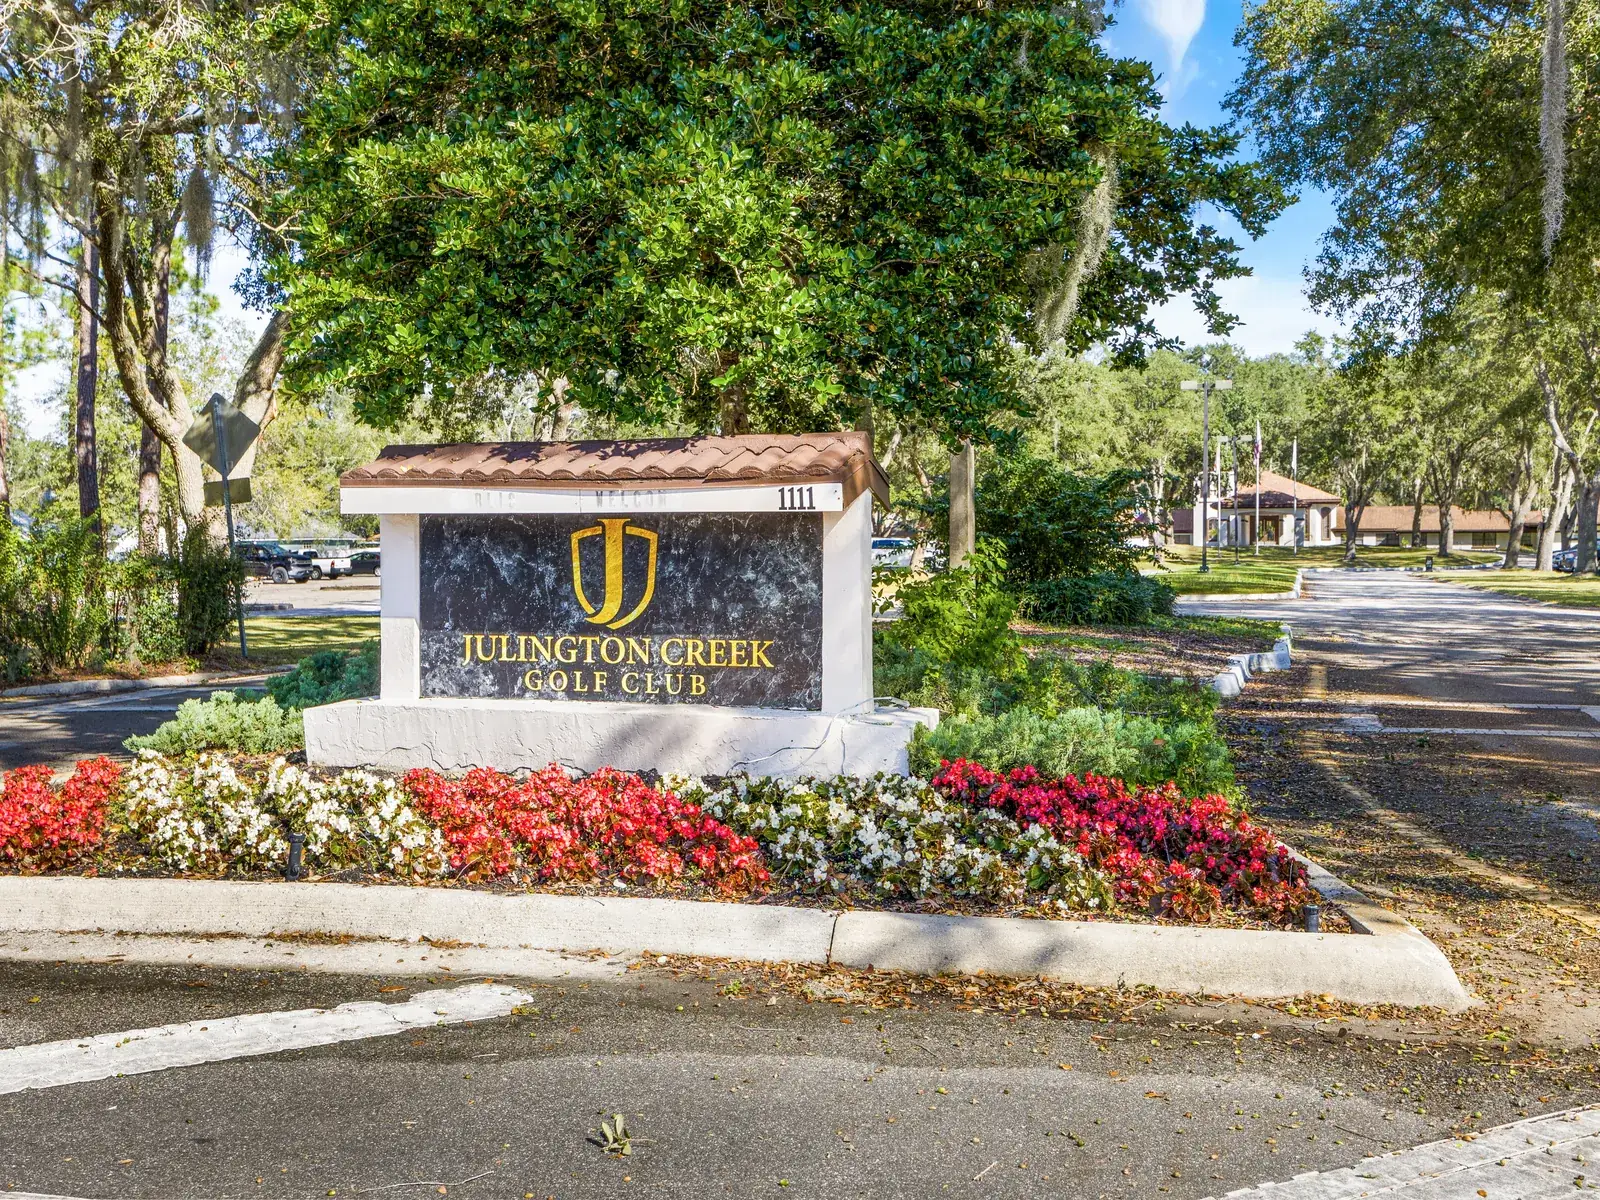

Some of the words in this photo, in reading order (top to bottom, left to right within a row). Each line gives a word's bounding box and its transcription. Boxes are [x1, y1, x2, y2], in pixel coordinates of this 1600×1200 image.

[778, 486, 816, 510] 1111
[461, 633, 652, 667] JULINGTON
[660, 638, 775, 668] CREEK
[524, 669, 608, 692] GOLF
[621, 672, 707, 695] CLUB
